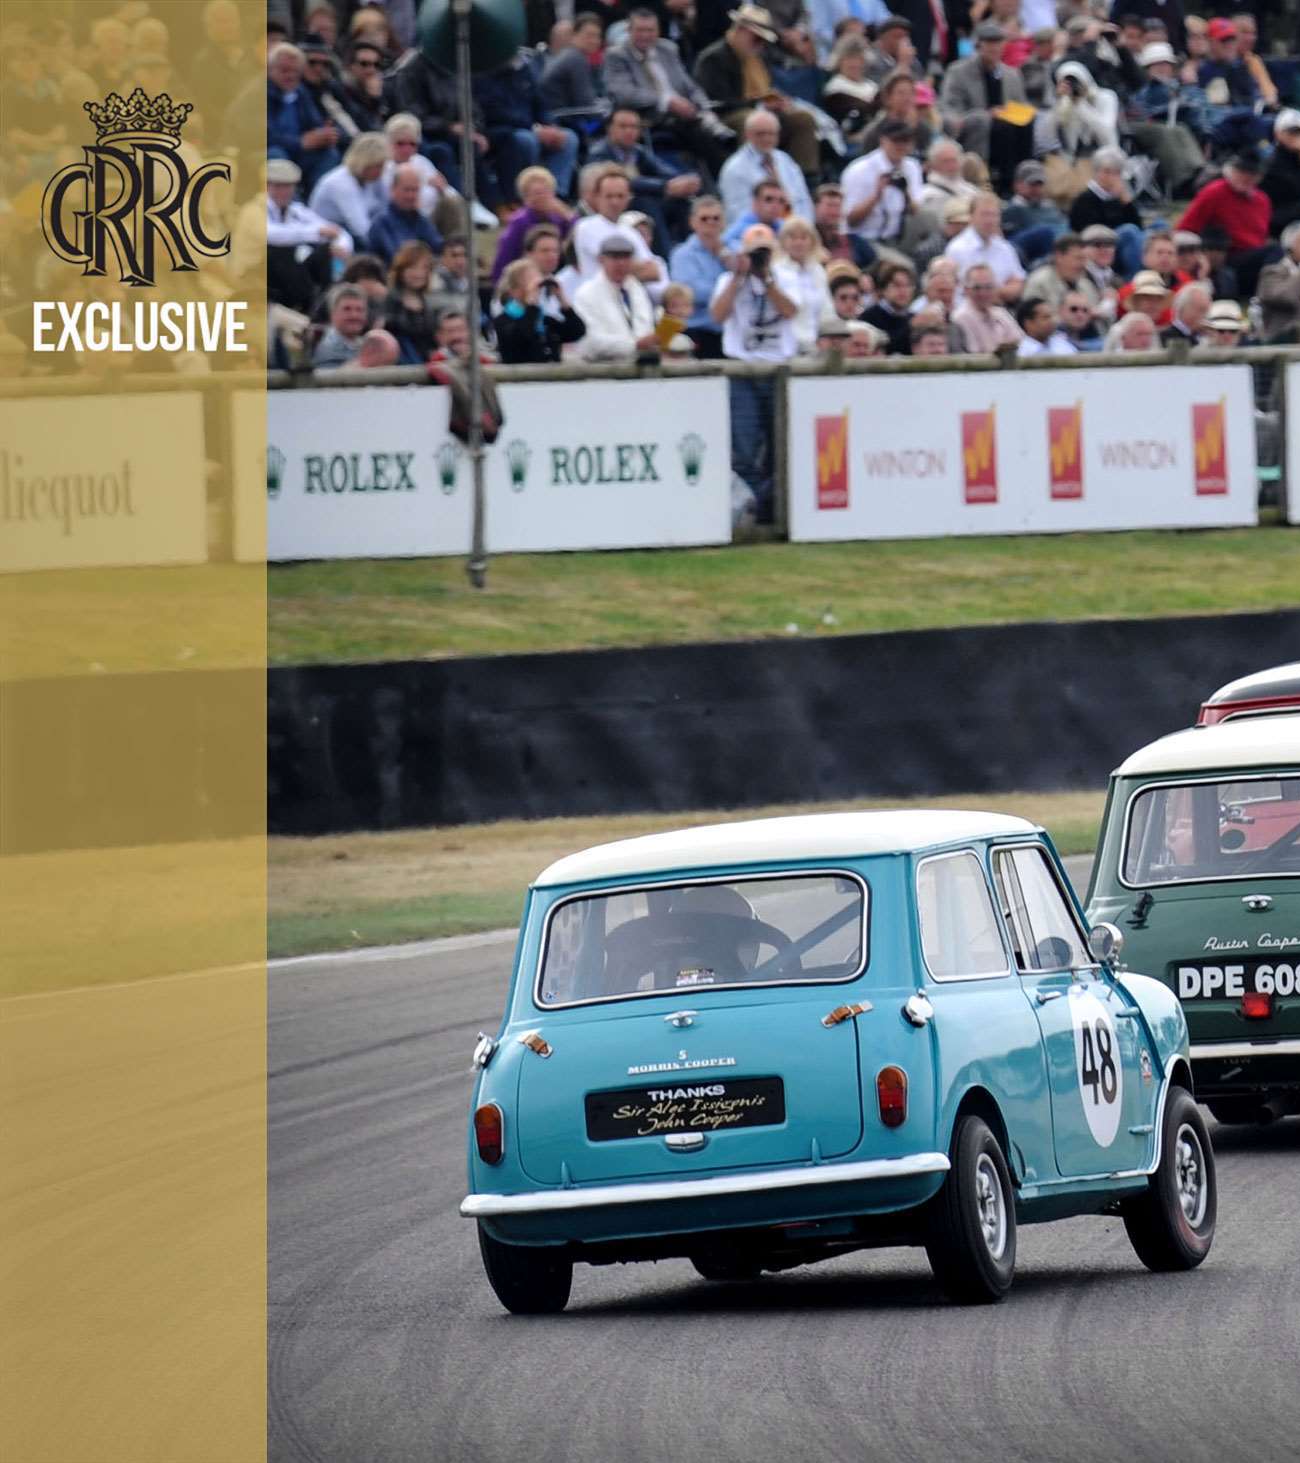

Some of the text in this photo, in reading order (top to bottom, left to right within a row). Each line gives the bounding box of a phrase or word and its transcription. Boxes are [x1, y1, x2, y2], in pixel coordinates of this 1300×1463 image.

[549, 443, 660, 484] ROLEX
[864, 449, 945, 478] WINTON
[1100, 440, 1176, 470] WINTON
[304, 452, 416, 494] ROLEX
[1203, 936, 1249, 951] Austin
[1178, 966, 1245, 999] DPE
[628, 1057, 736, 1074] MORRIS COOPER
[1081, 1017, 1117, 1105] 48
[648, 1085, 726, 1101] THANKS
[612, 1104, 645, 1119] Sir
[646, 1101, 686, 1117] Alec
[637, 1112, 744, 1135] John Cooper
